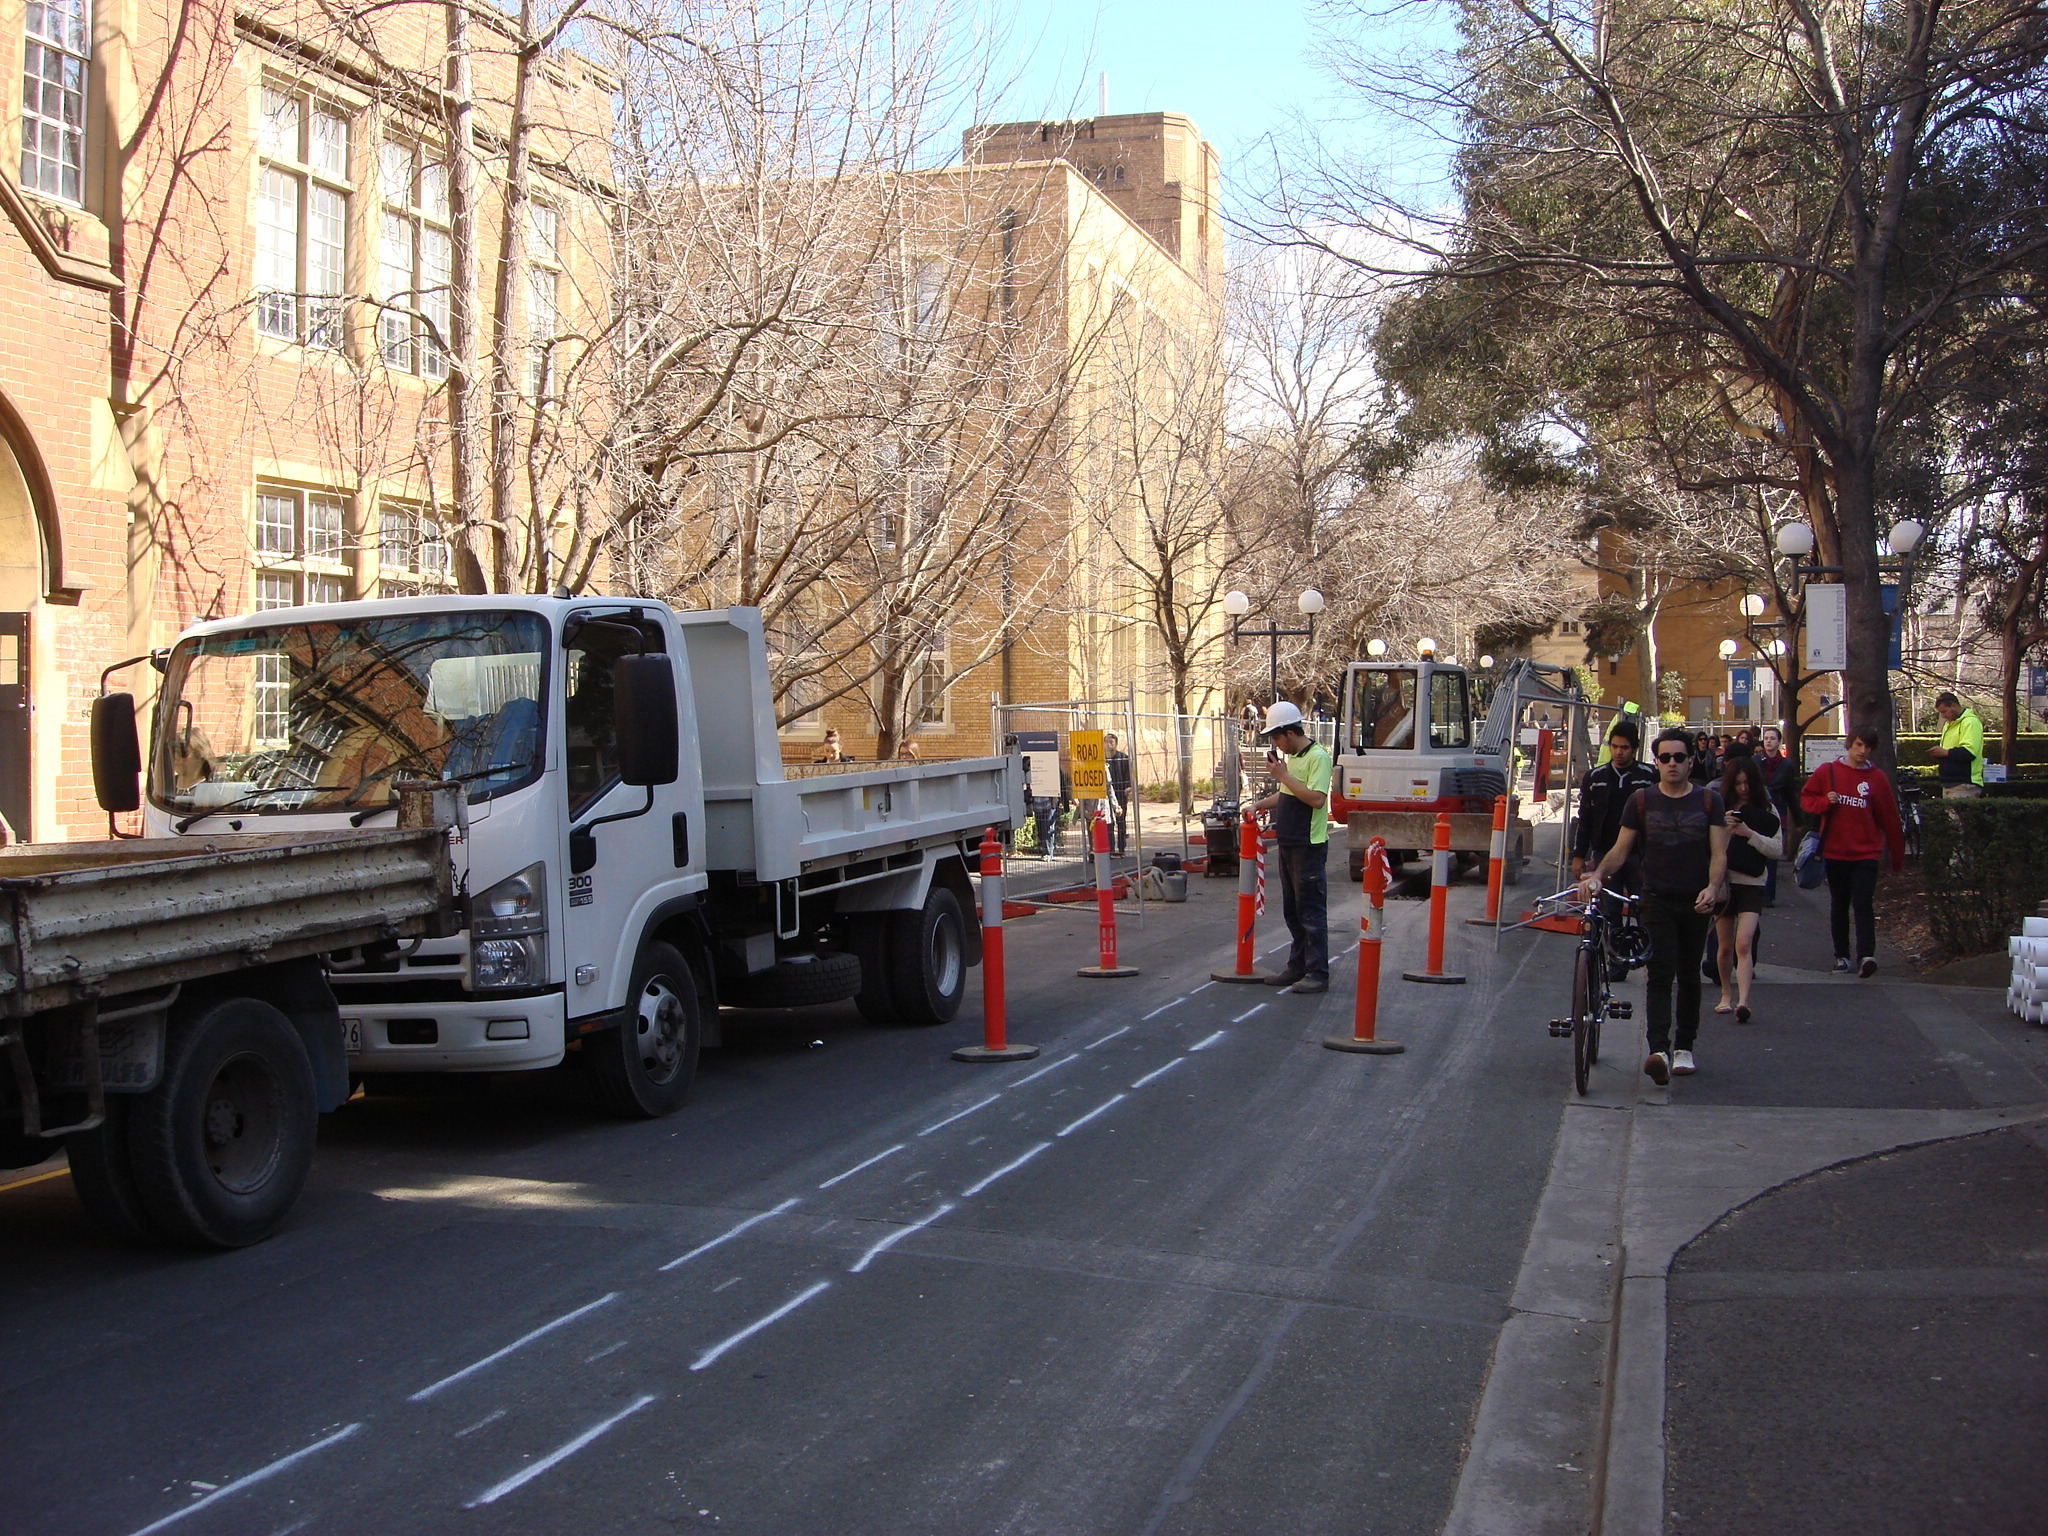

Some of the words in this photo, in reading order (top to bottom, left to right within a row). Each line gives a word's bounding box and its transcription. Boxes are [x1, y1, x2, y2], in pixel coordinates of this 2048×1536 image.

[1076, 744, 1098, 761] ROAD
[1073, 770, 1104, 787] CLOSED
[568, 875, 592, 889] 300
